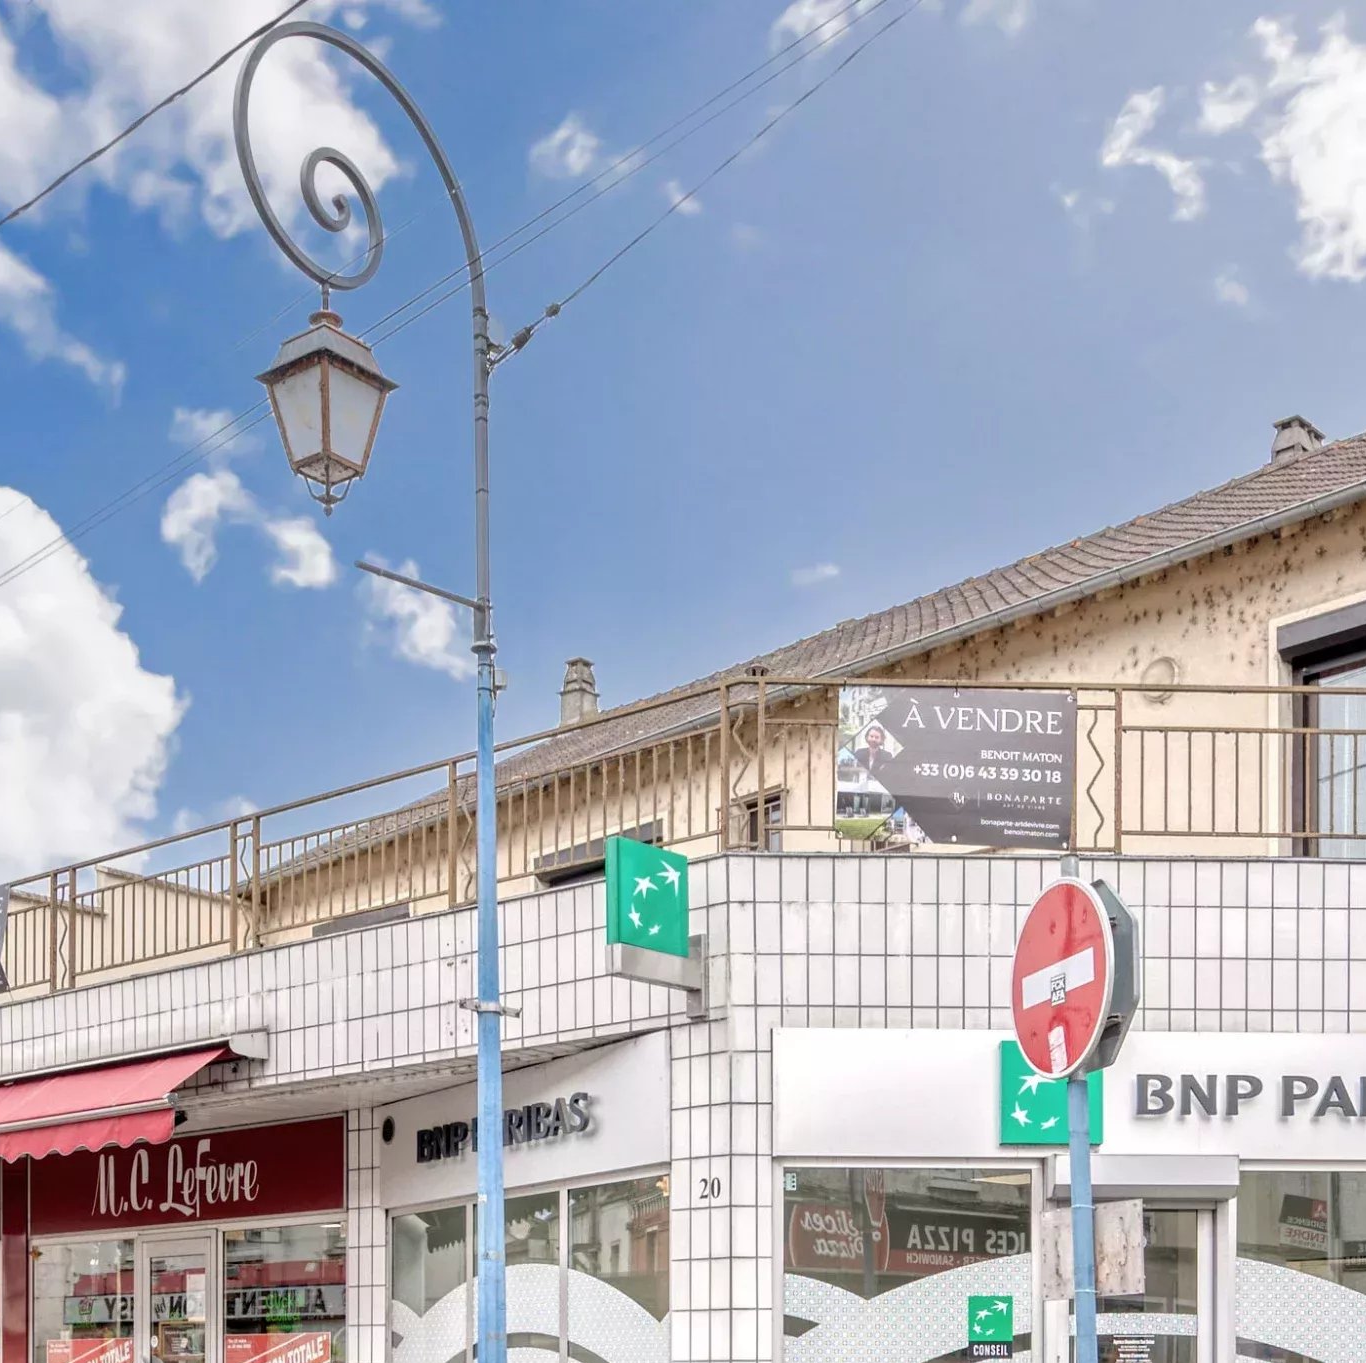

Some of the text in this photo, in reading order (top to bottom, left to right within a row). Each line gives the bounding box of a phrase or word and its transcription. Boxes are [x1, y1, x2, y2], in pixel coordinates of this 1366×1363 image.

[902, 698, 1063, 735] À VENDRE
[981, 750, 1062, 763] BENOIT MATON
[913, 763, 1062, 783] +33 (0)6 43 39 30 18
[986, 793, 1062, 805] BONAPARTE
[1135, 1074, 1263, 1116] BNP
[416, 1092, 590, 1163] BNP RIBAS
[699, 1177, 721, 1199] 20
[973, 1344, 1008, 1356] CONSEIL
